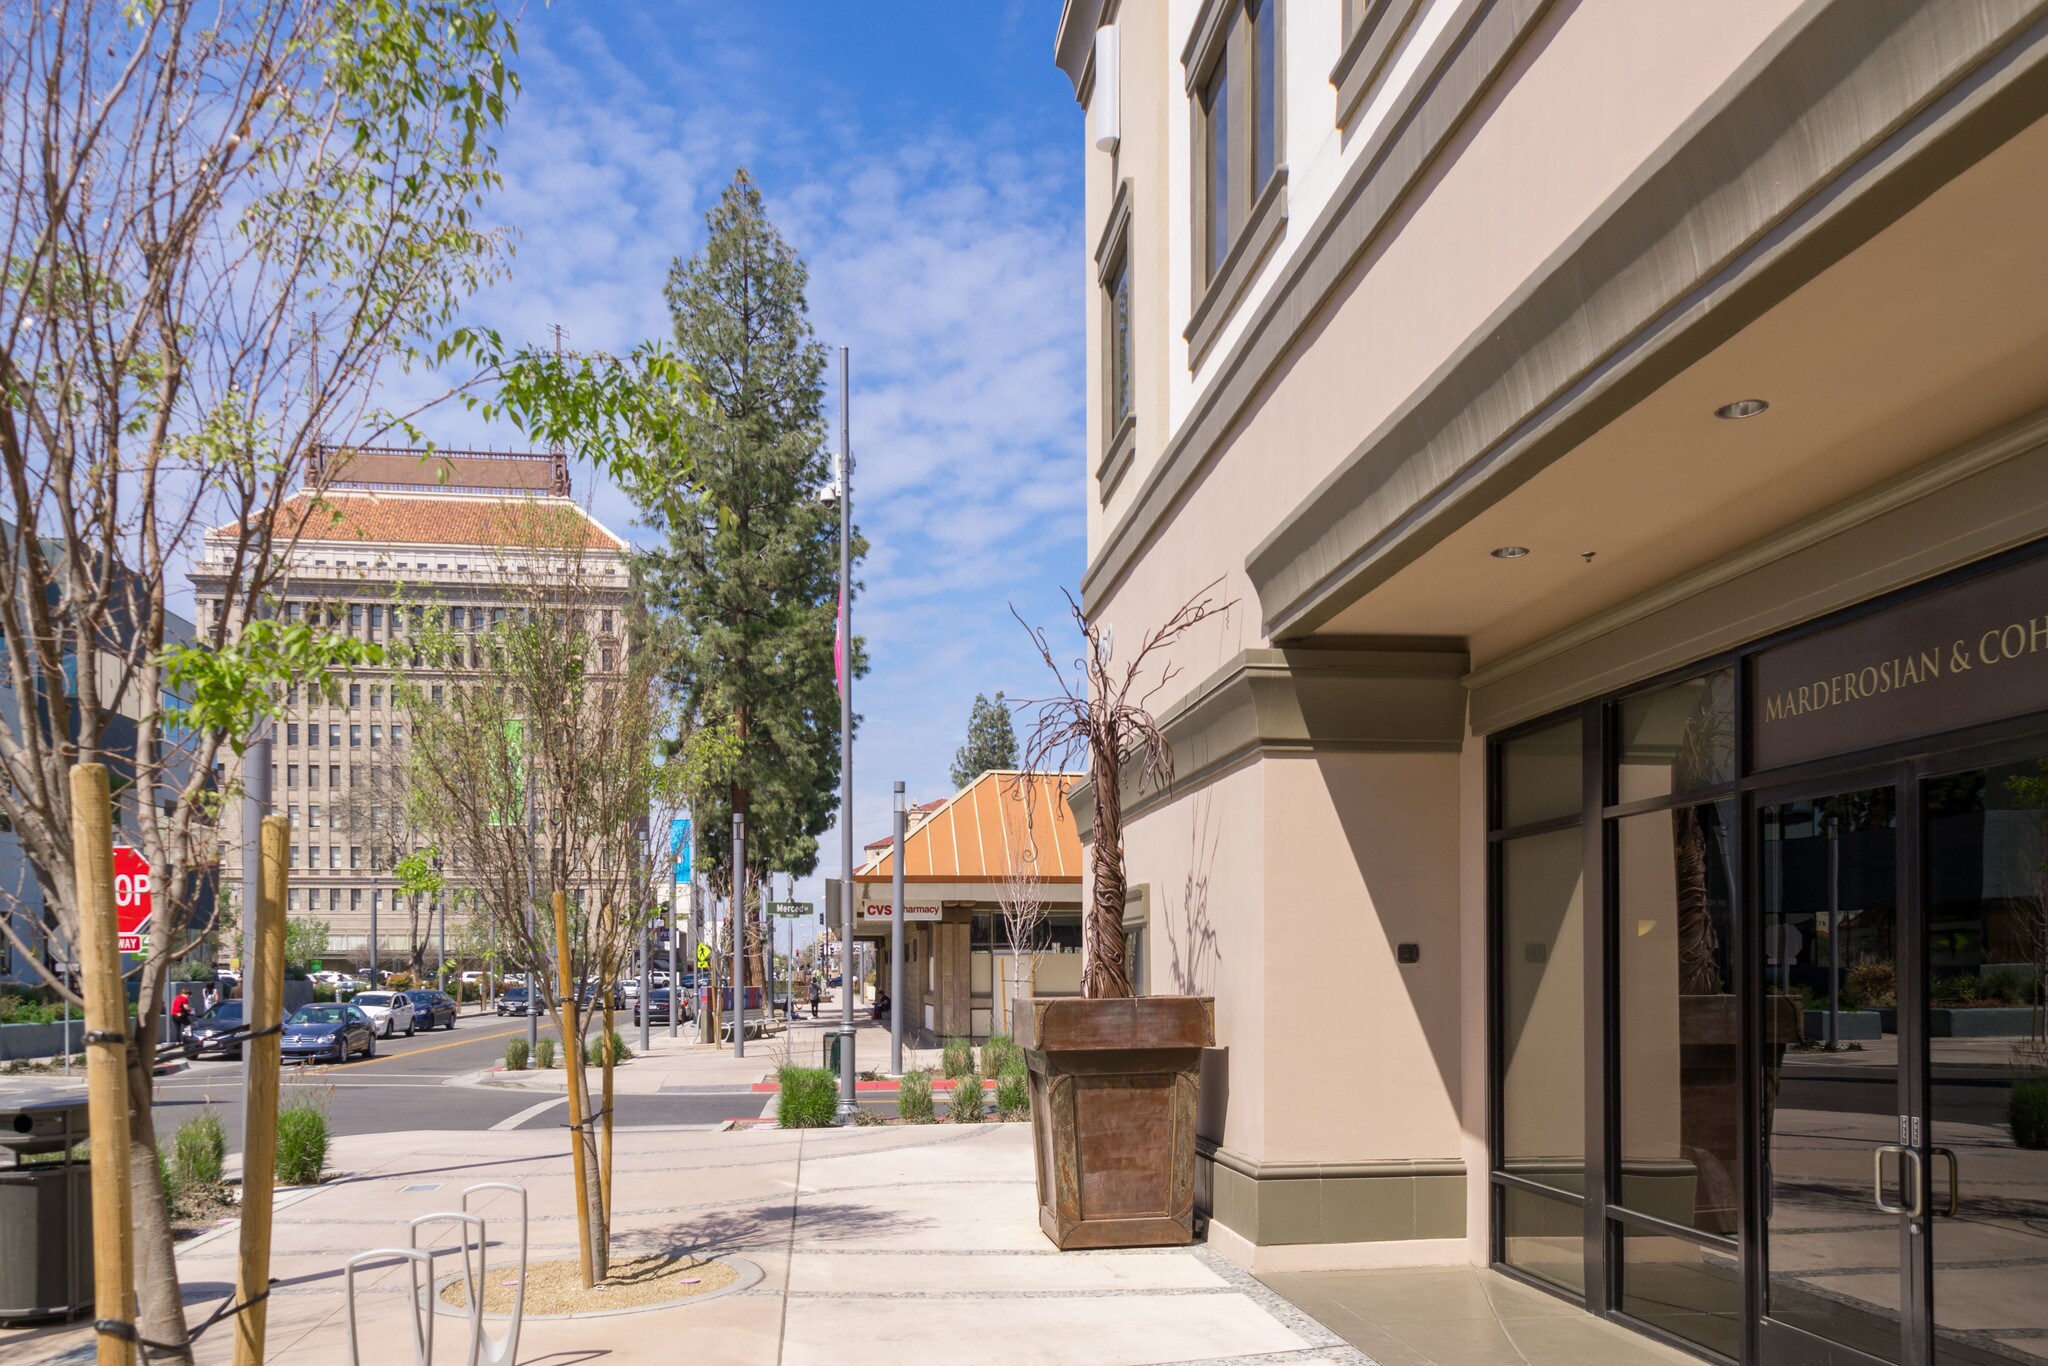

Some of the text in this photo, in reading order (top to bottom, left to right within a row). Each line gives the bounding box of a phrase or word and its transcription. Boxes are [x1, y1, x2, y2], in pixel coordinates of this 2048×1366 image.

[1765, 614, 2048, 723] MARDEROSIAN & COH
[115, 873, 152, 907] OP
[776, 903, 804, 913] Merced
[867, 904, 940, 916] CVS harmacy
